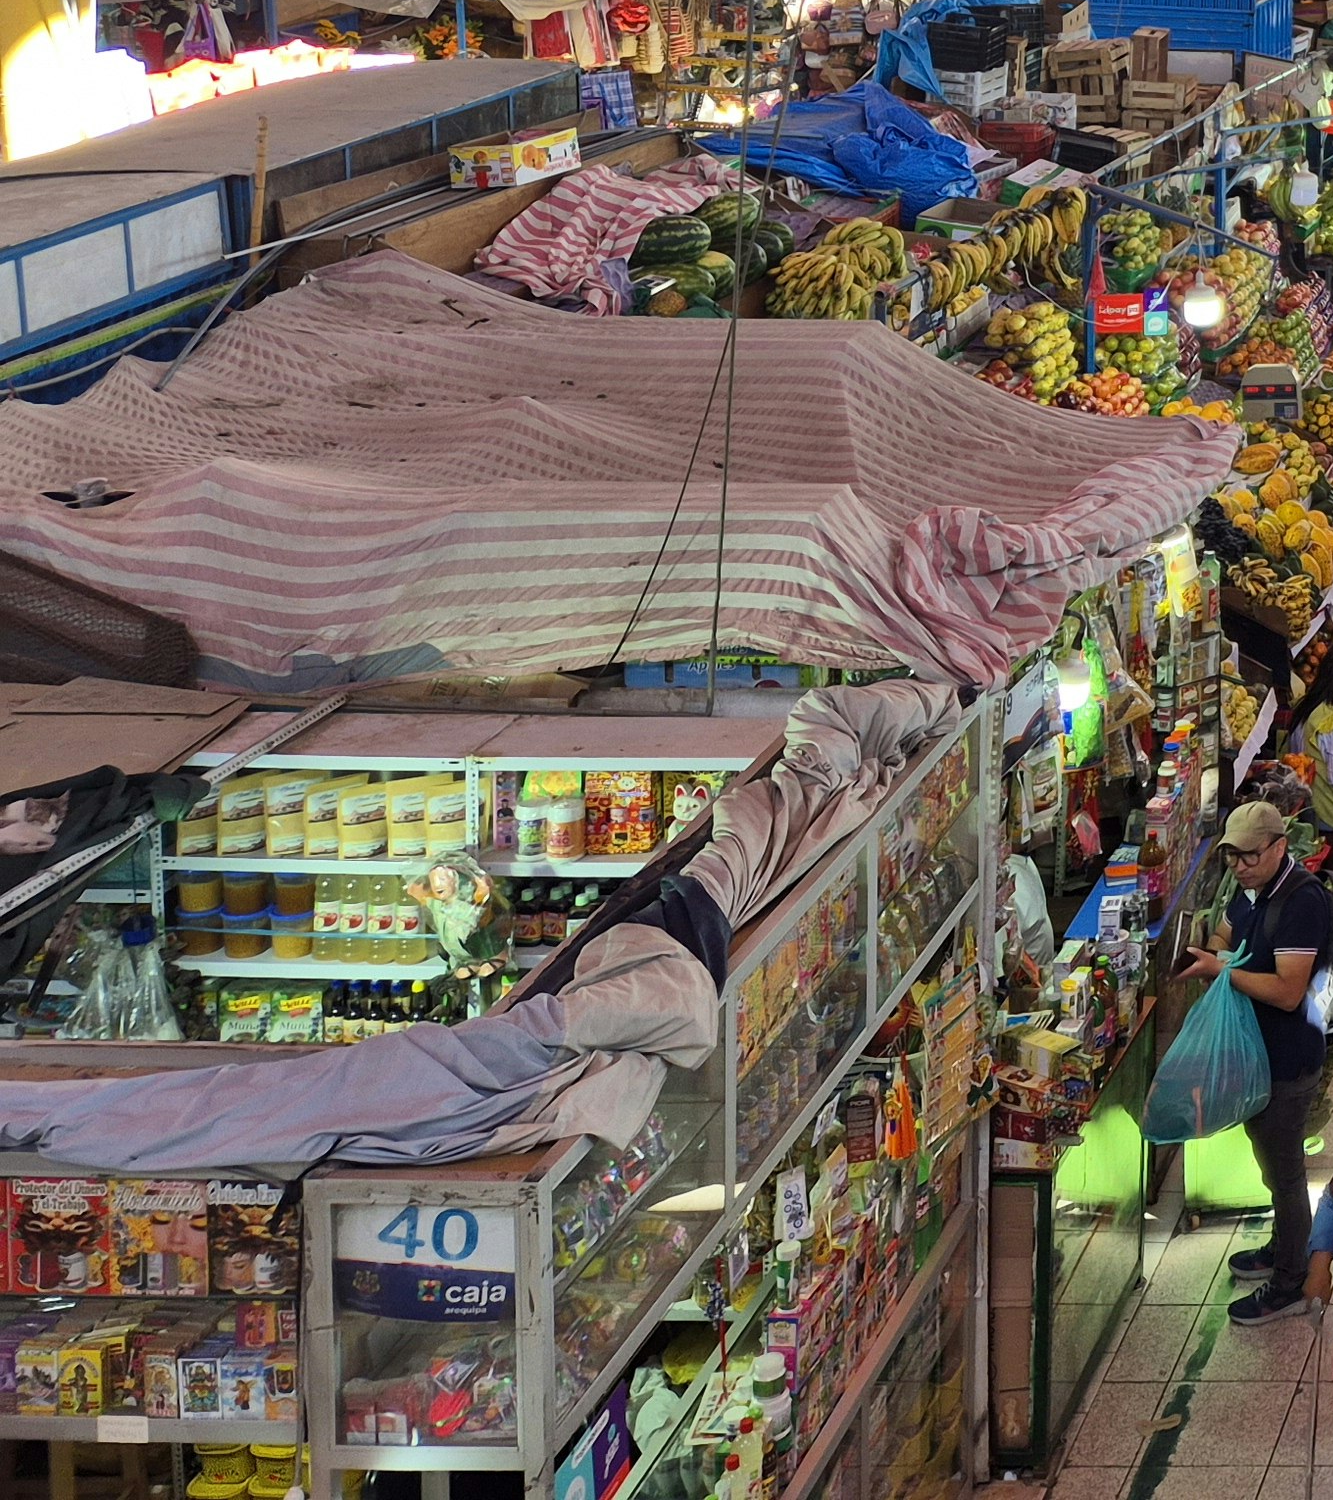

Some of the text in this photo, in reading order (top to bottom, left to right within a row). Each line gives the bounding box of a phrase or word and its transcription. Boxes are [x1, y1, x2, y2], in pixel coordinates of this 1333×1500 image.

[13, 1180, 107, 1196] Protector del Dinero
[51, 1200, 88, 1213] Trabajo
[377, 1204, 479, 1262] 40
[445, 1280, 507, 1306] caja
[444, 1306, 487, 1316] arequipa
